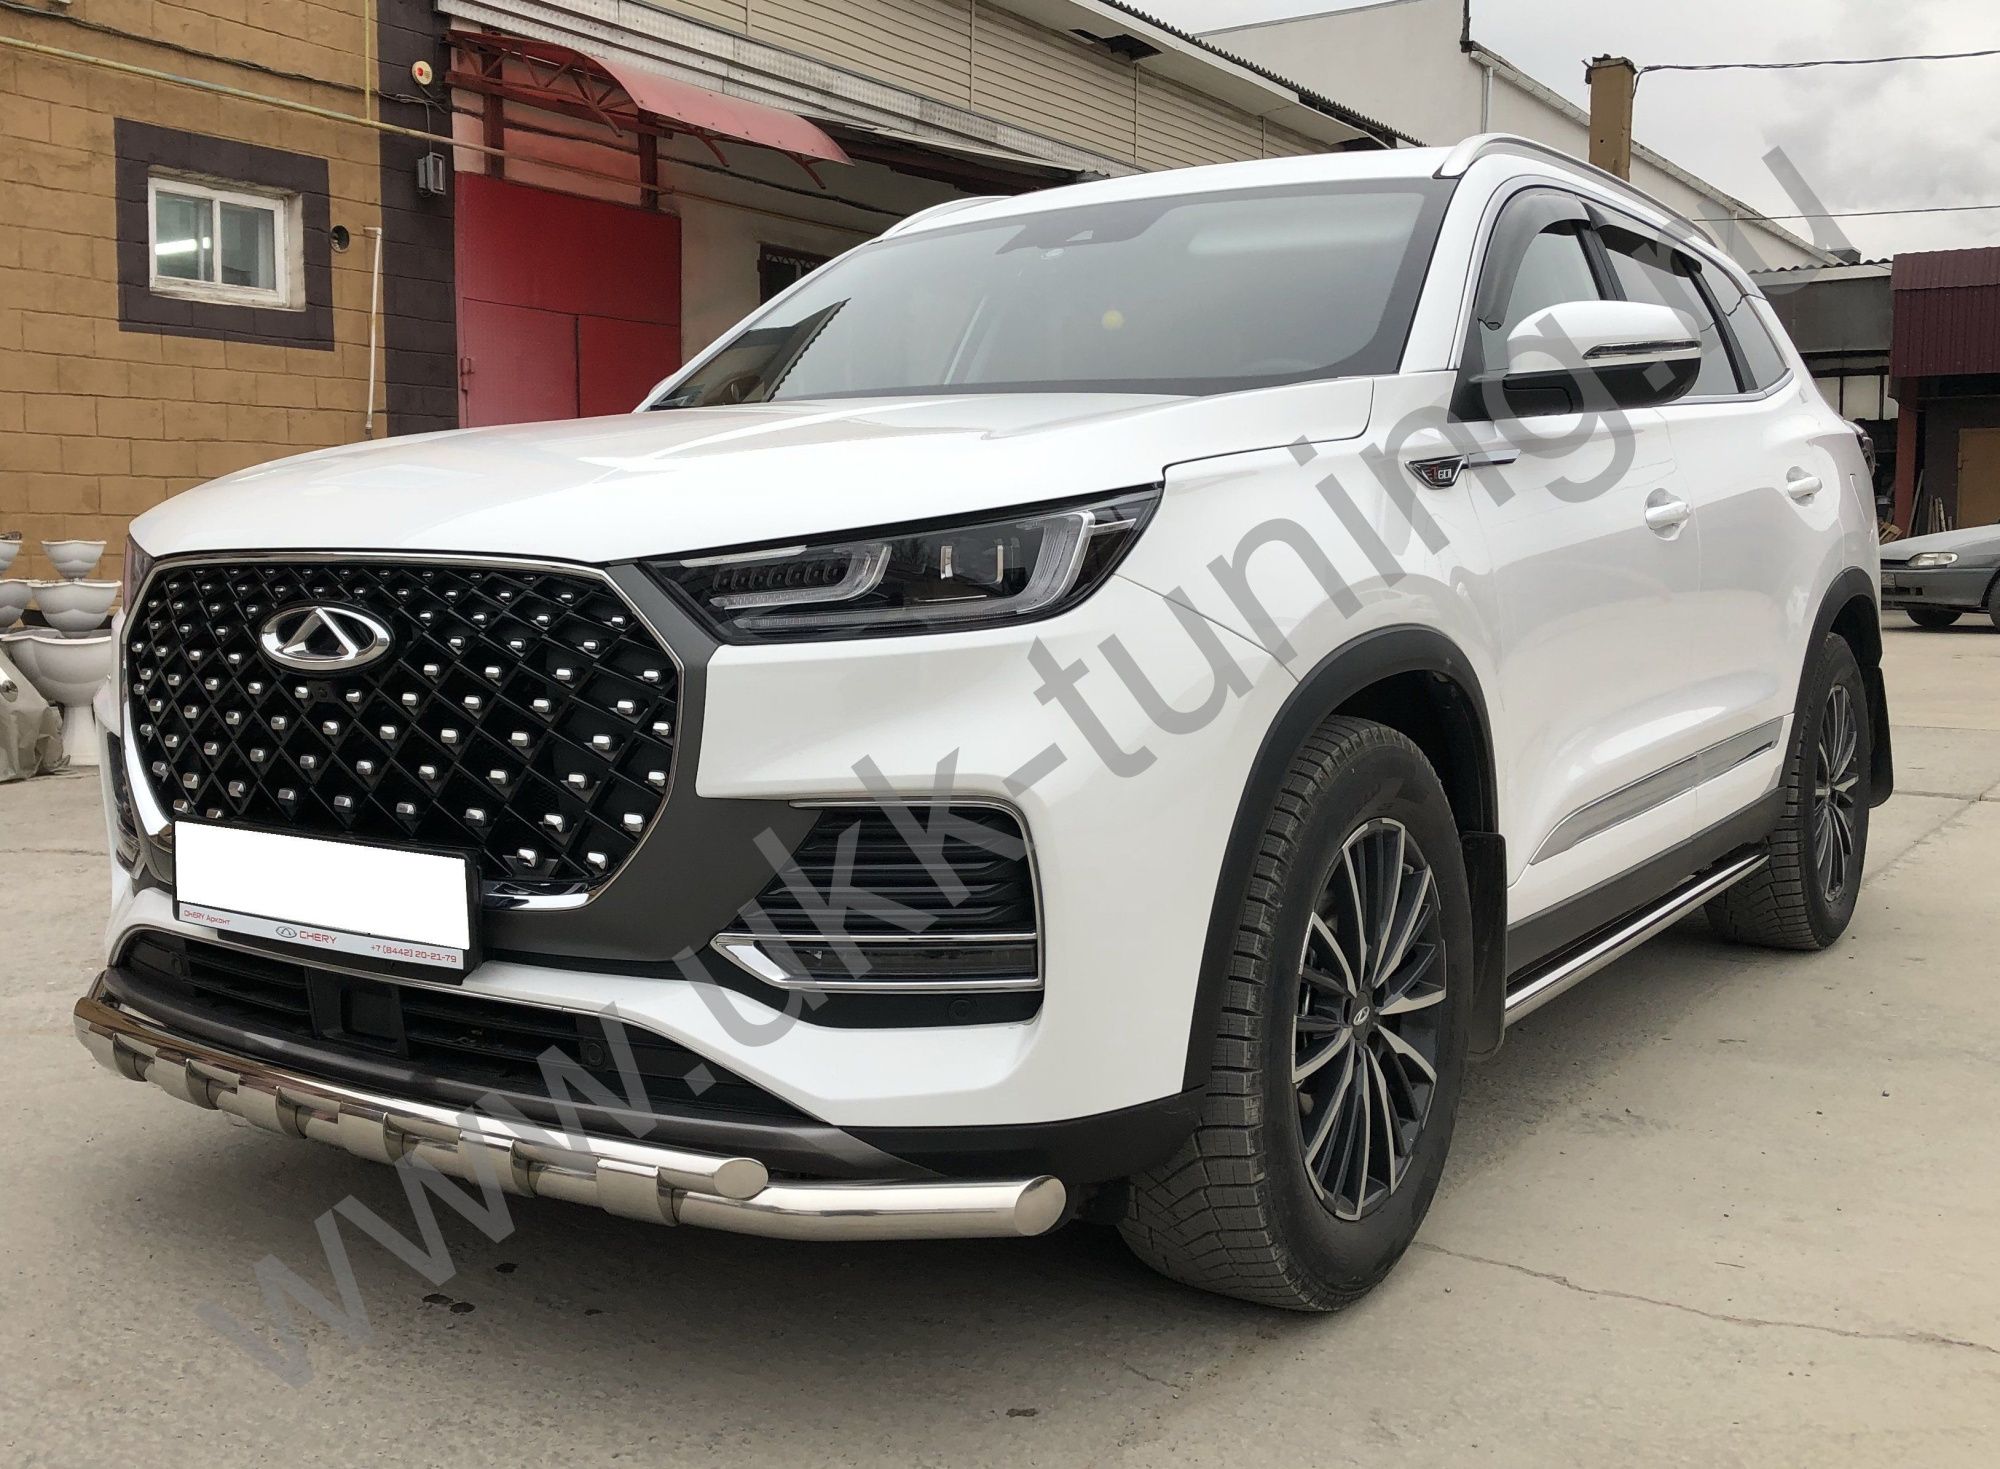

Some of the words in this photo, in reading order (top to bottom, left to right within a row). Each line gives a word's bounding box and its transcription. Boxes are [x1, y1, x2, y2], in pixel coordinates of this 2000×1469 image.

[299, 930, 337, 944] CHERY
[370, 944, 381, 952] +7
[382, 944, 413, 958] (8442)
[415, 950, 457, 963] 20-21-79
